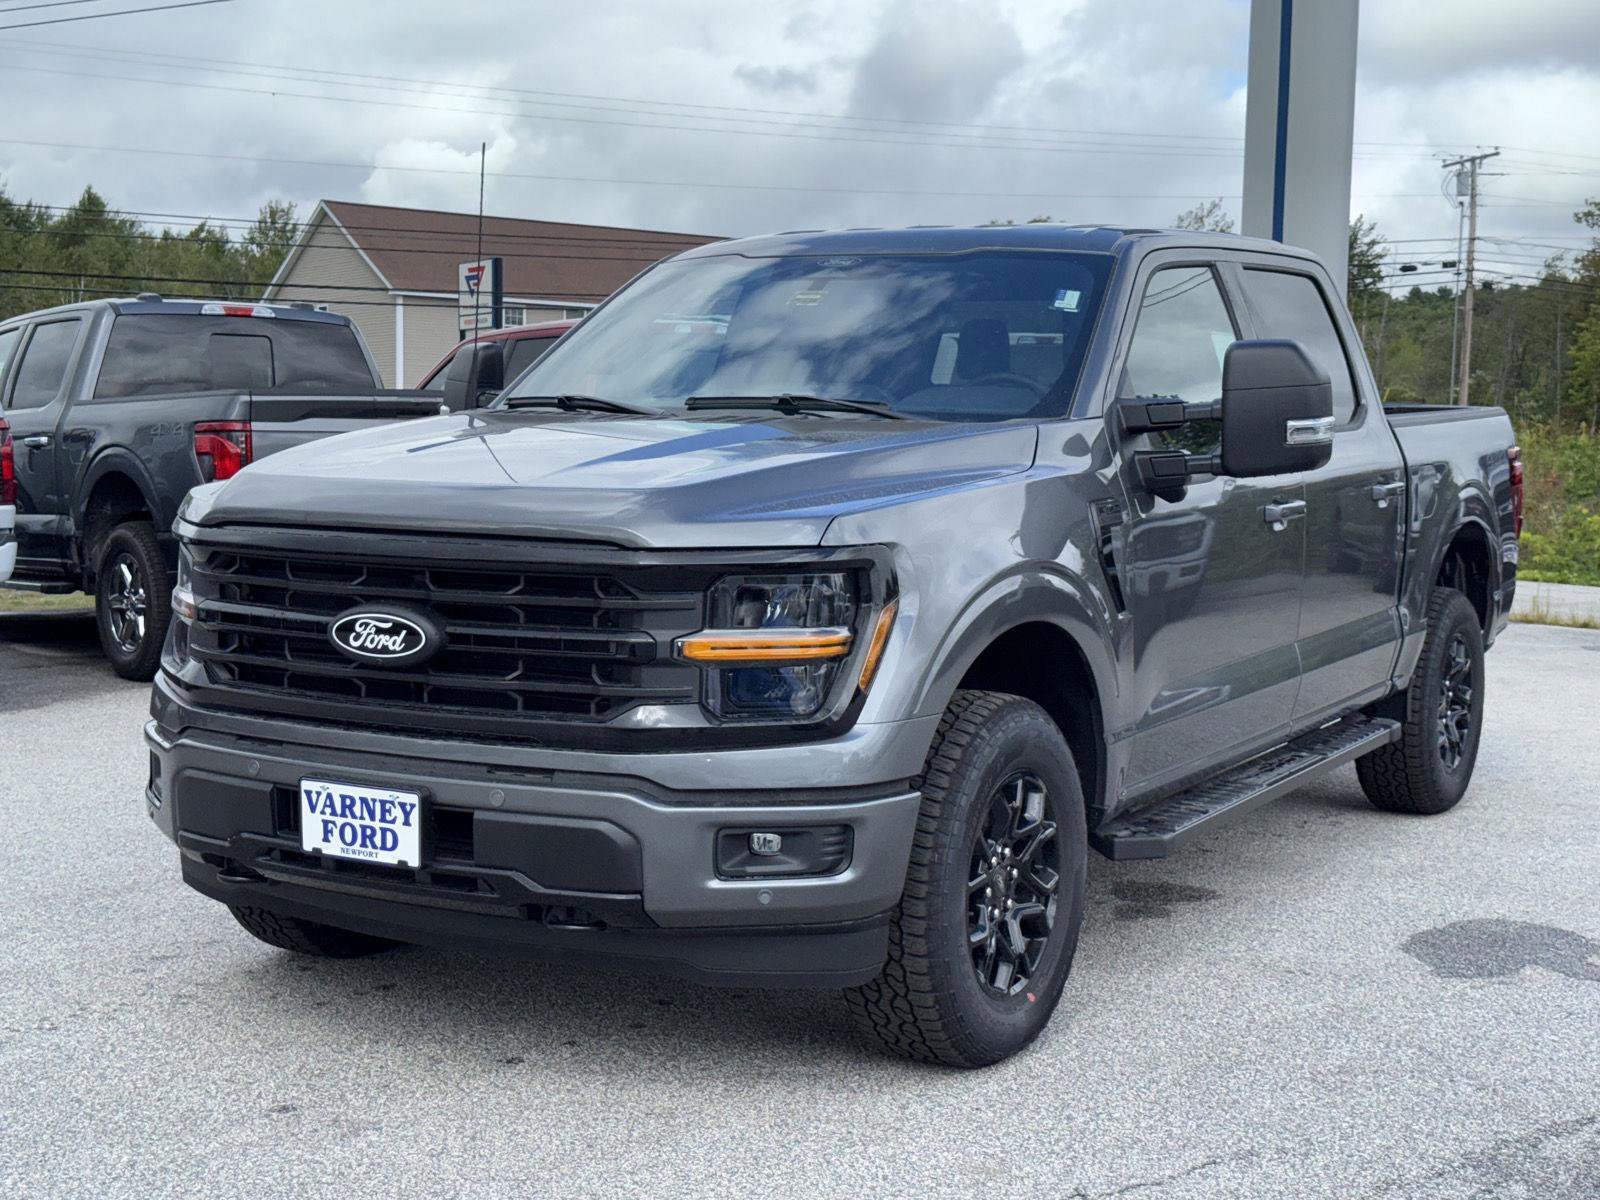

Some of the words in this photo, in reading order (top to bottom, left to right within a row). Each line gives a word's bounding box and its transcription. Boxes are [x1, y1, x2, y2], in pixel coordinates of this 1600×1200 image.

[349, 619, 407, 651] Ford
[303, 789, 416, 827] VARNEY
[321, 818, 399, 852] FORD
[340, 847, 379, 859] NEWPORT
